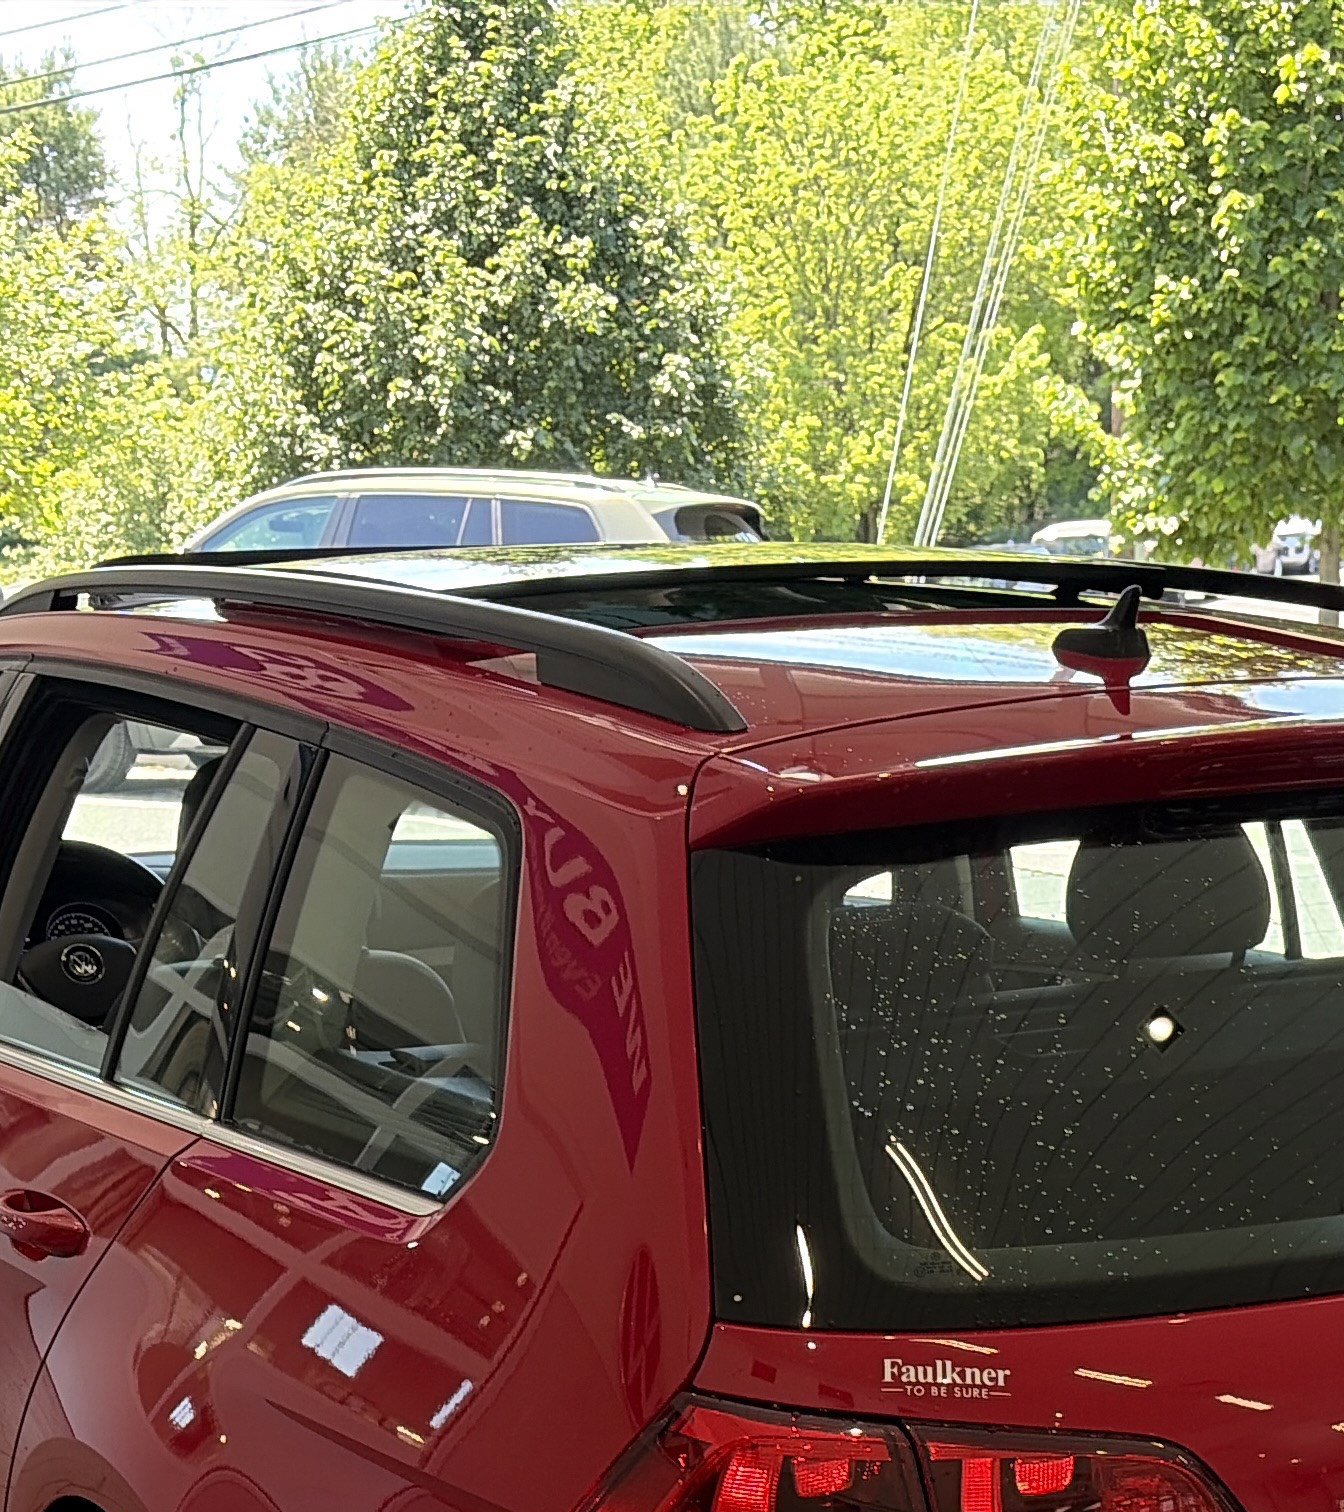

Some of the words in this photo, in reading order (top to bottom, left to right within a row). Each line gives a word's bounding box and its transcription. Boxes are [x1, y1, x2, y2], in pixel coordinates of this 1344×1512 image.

[881, 1358, 1011, 1387] Faulkner
[905, 1384, 926, 1397] TO
[930, 1385, 948, 1398] BE
[953, 1386, 989, 1399] SURE
